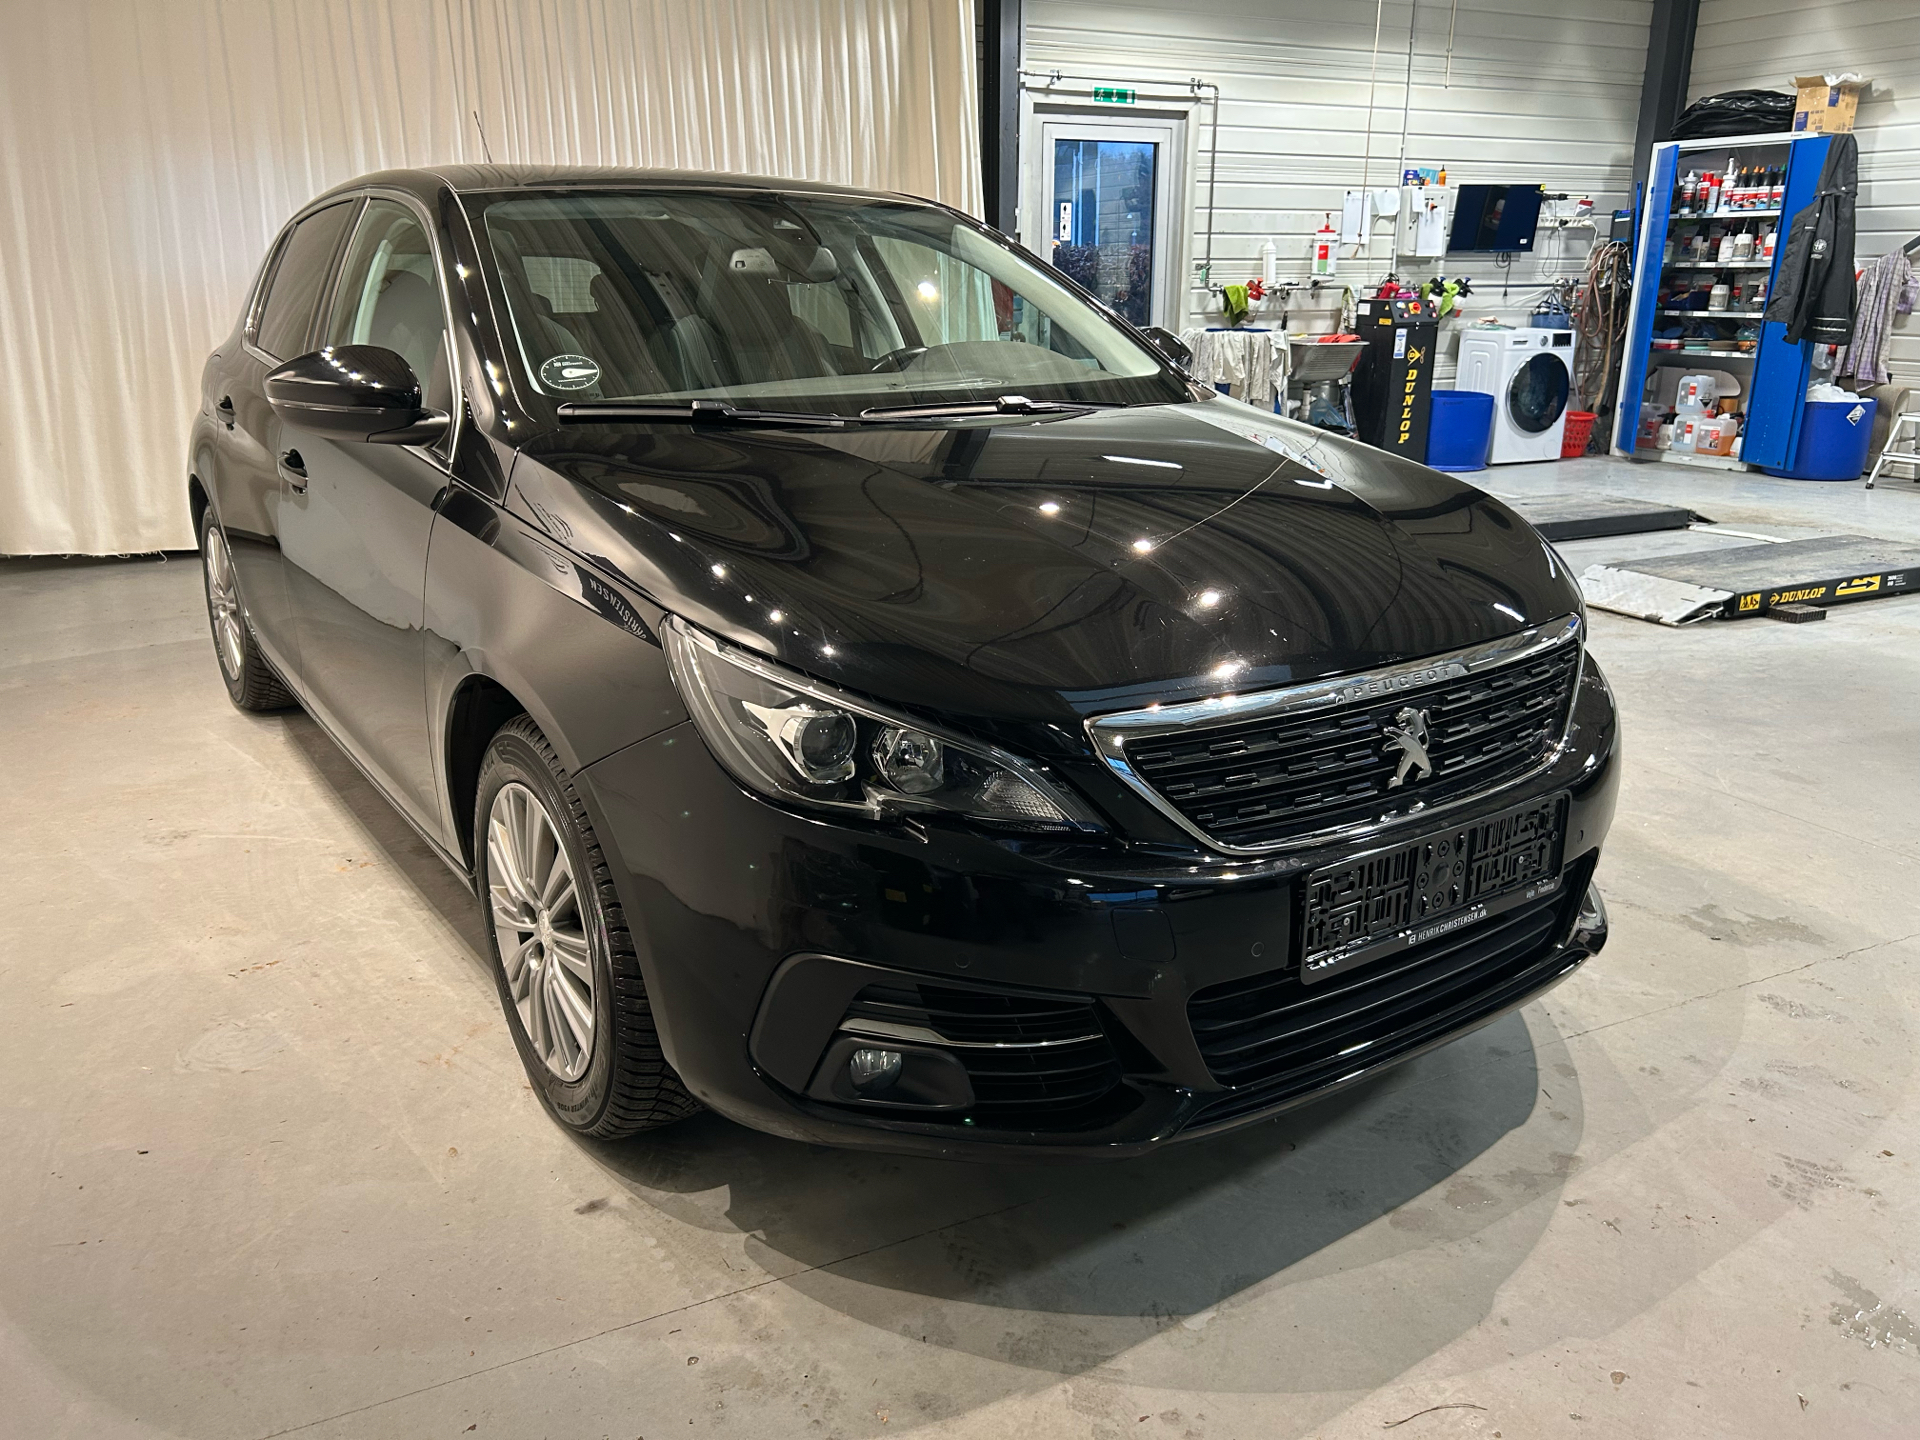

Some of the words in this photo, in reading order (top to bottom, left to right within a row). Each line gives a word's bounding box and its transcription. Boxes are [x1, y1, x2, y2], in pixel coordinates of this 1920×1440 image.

[1398, 369, 1418, 444] DUNLOP
[1779, 587, 1826, 603] DUNLOP
[1353, 667, 1450, 698] PEUGEOT
